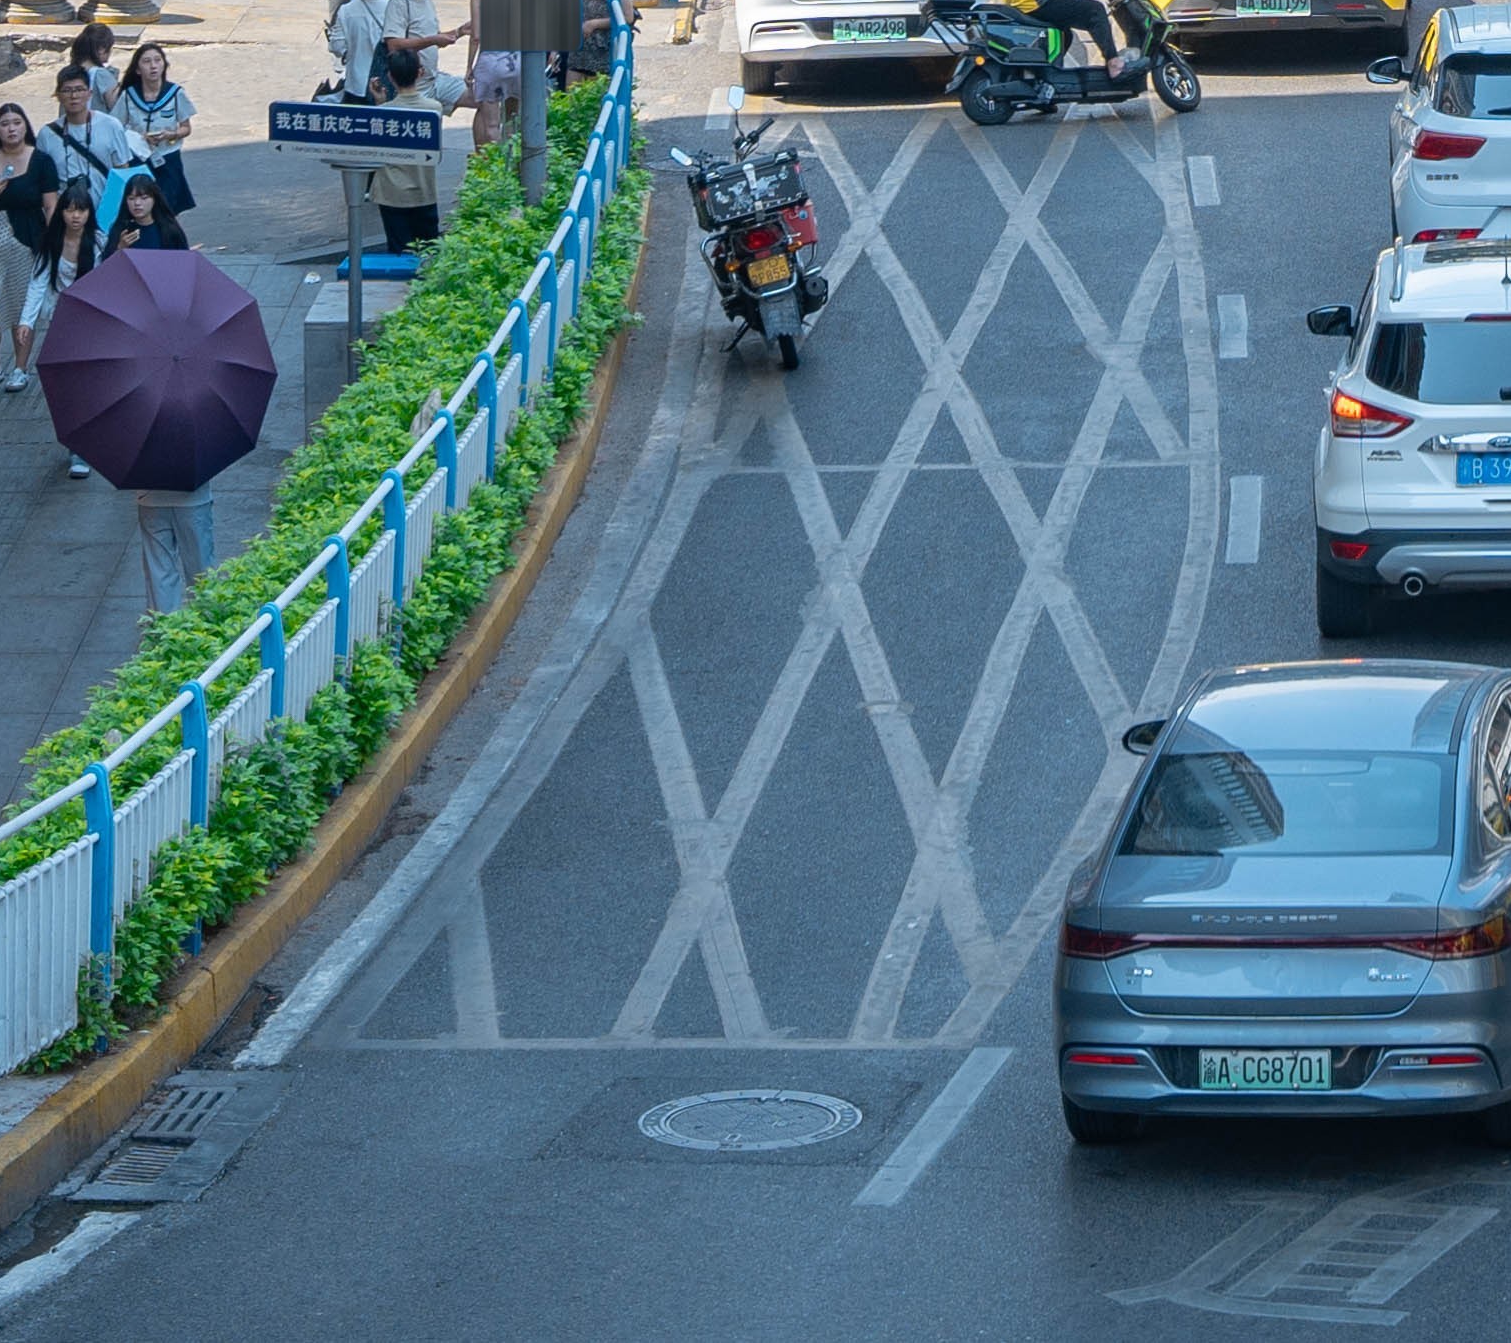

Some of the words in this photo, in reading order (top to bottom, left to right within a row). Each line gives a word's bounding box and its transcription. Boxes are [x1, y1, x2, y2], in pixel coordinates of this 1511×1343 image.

[275, 111, 433, 140] 我在重庆吃二筒老火锅
[1242, 1056, 1326, 1085] CG8701
